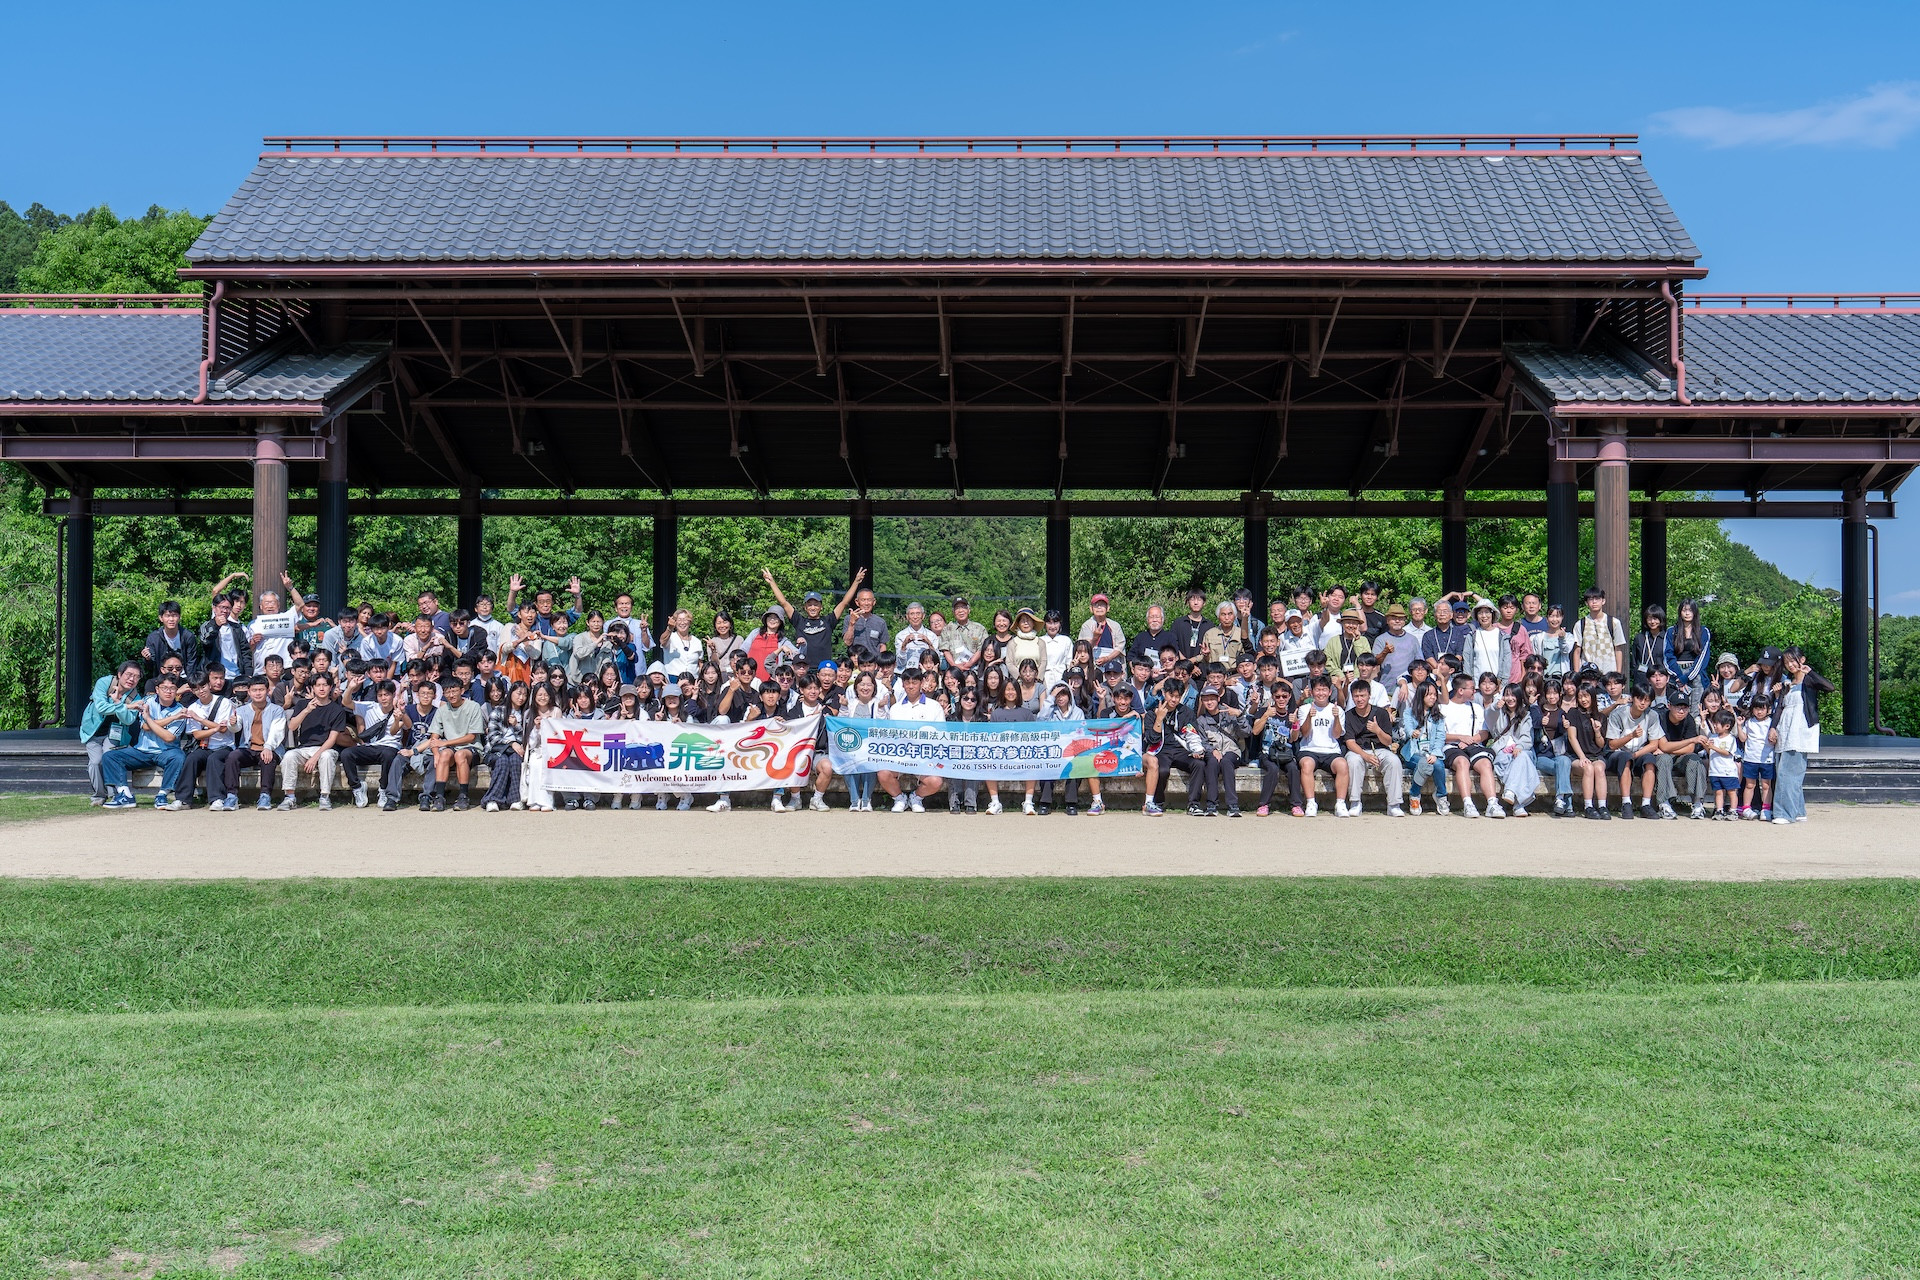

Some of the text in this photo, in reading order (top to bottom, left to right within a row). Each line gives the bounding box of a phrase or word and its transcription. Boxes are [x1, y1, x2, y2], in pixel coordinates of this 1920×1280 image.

[1314, 718, 1330, 727] GAP
[868, 742, 1063, 760] 2026年日本國際教育參訪活動
[867, 756, 918, 769] Explore Japan
[634, 773, 672, 782] Welcome
[673, 774, 683, 782] to
